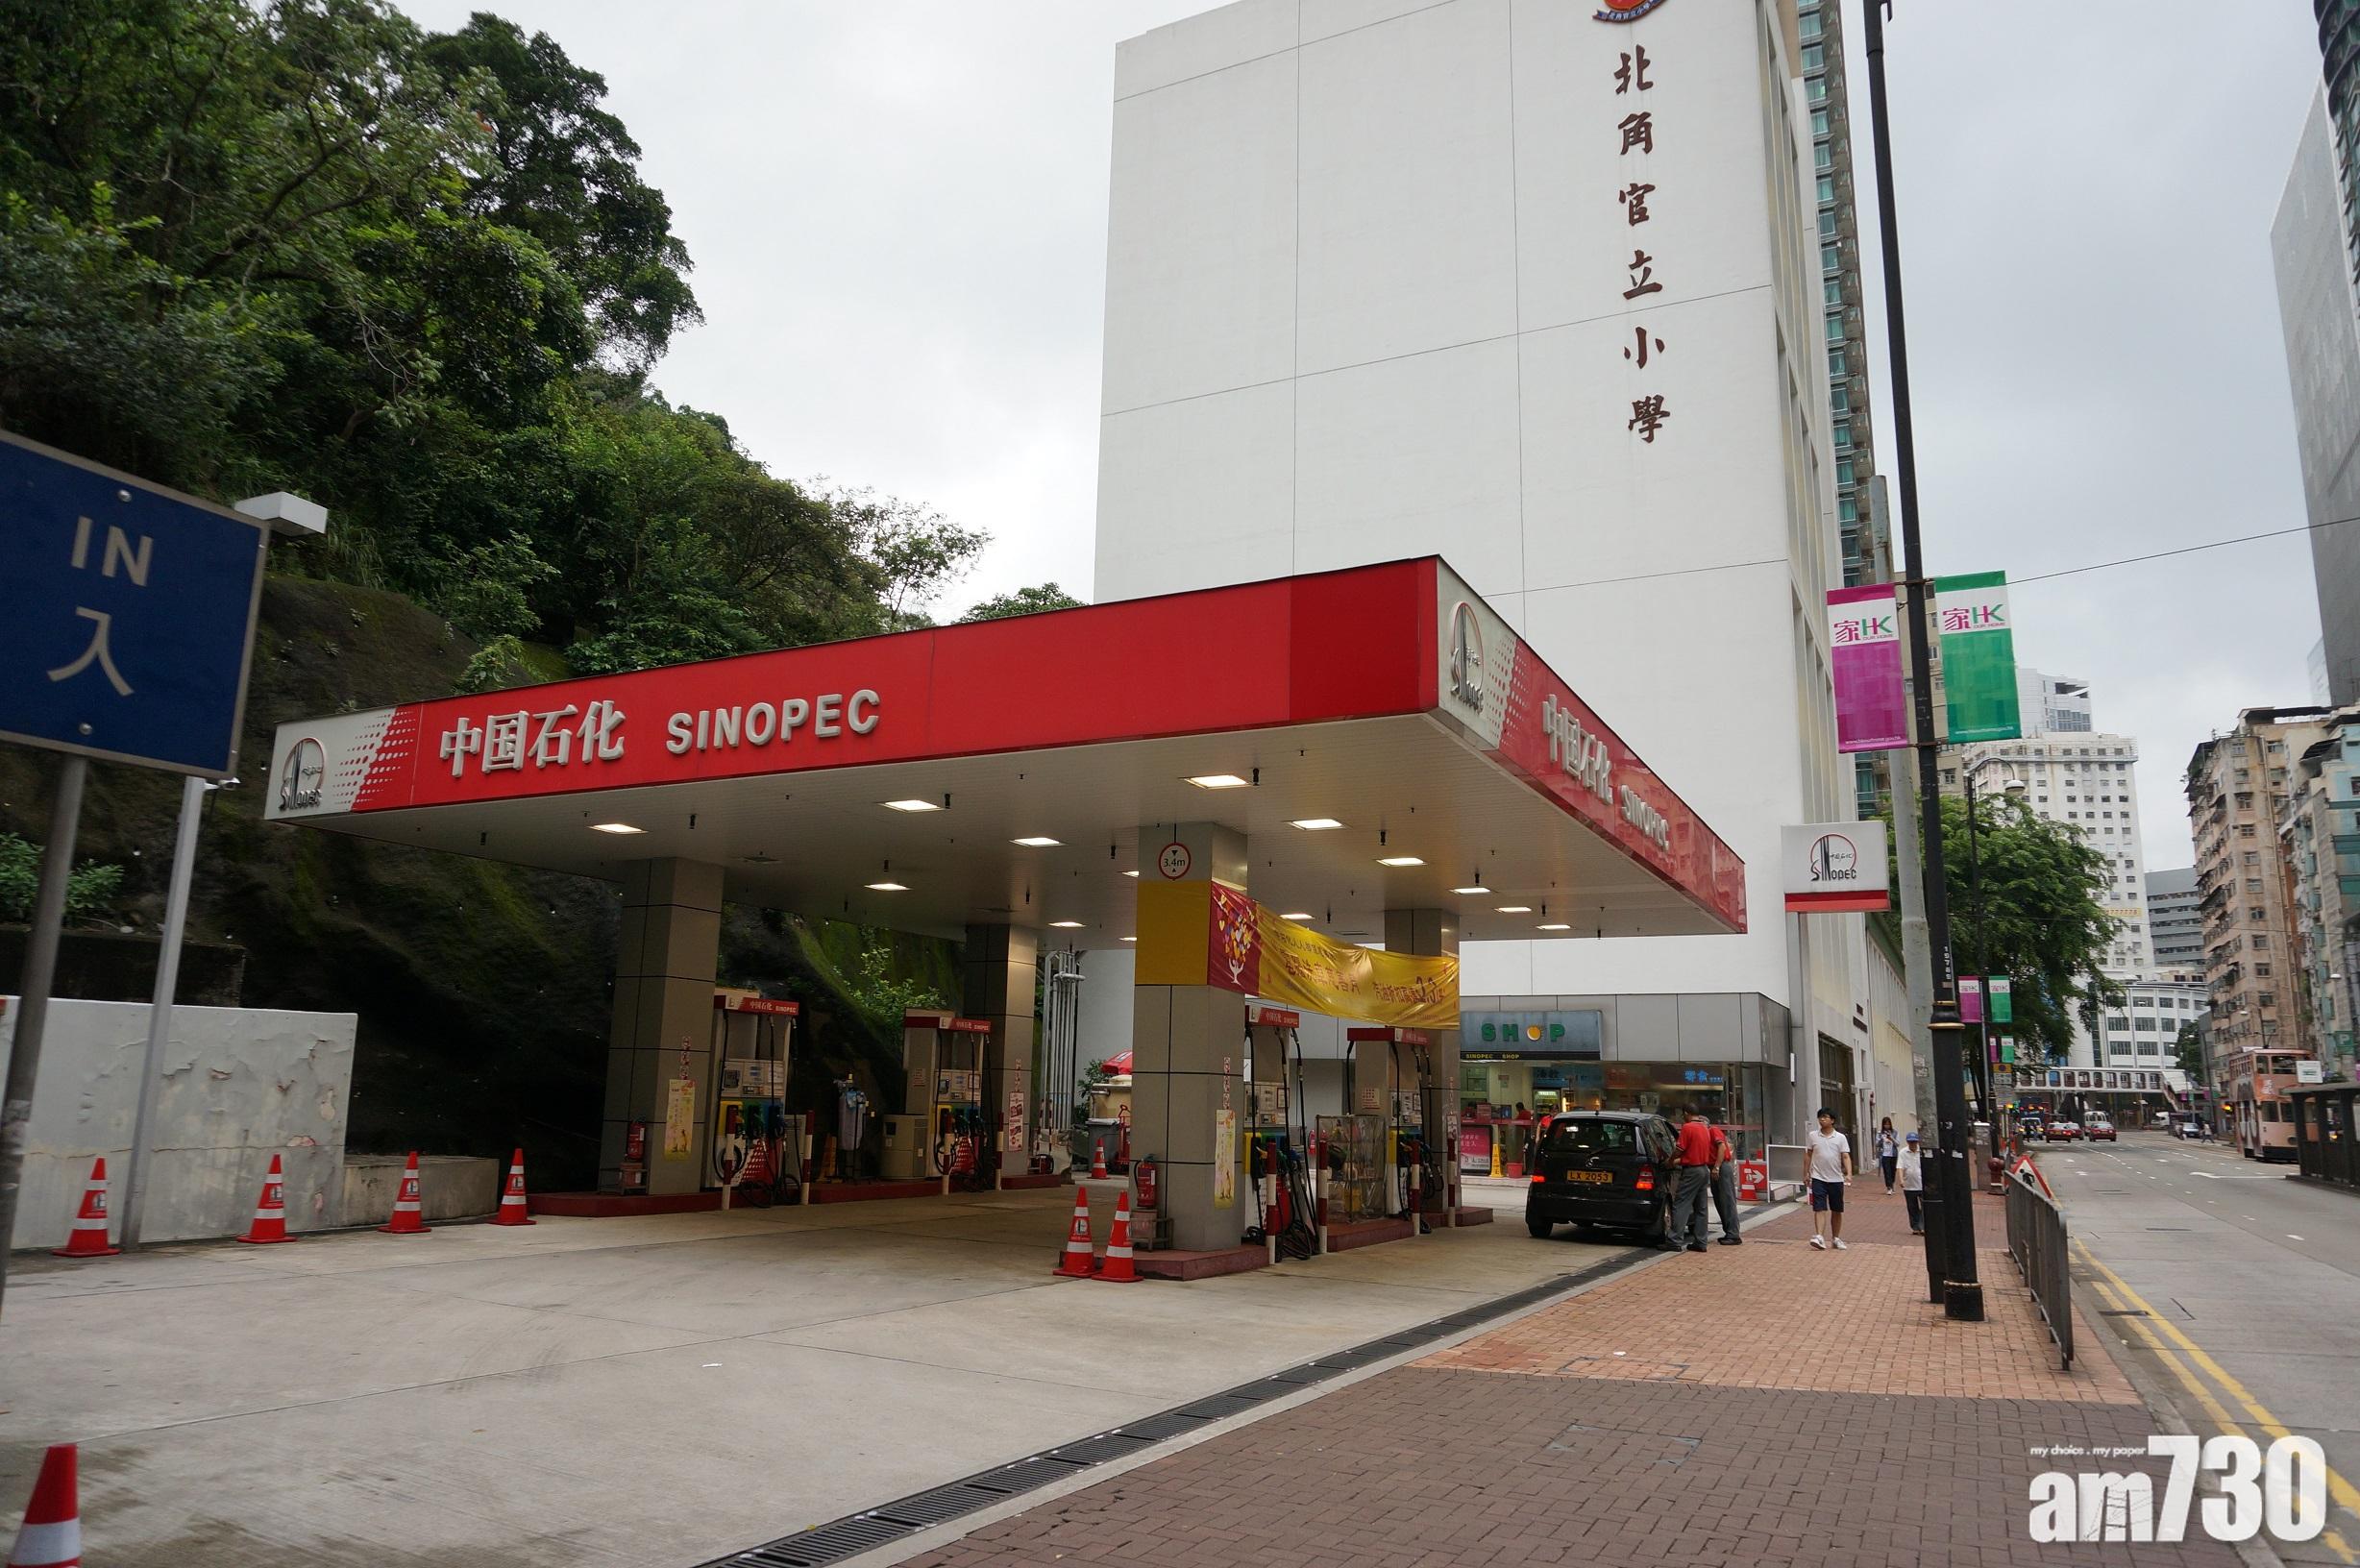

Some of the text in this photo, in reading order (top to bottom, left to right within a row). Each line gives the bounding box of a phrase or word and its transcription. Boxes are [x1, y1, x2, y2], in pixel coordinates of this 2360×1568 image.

[1613, 44, 1671, 444] 北角官立小學
[71, 516, 154, 587] IN
[47, 606, 135, 697] 入
[439, 688, 880, 778] 中国石化 SINOPEC
[1542, 693, 1669, 851] 中国石化 SINOPEC
[1163, 858, 1186, 868] 3.4m
[1570, 1171, 1610, 1182] LX 2053
